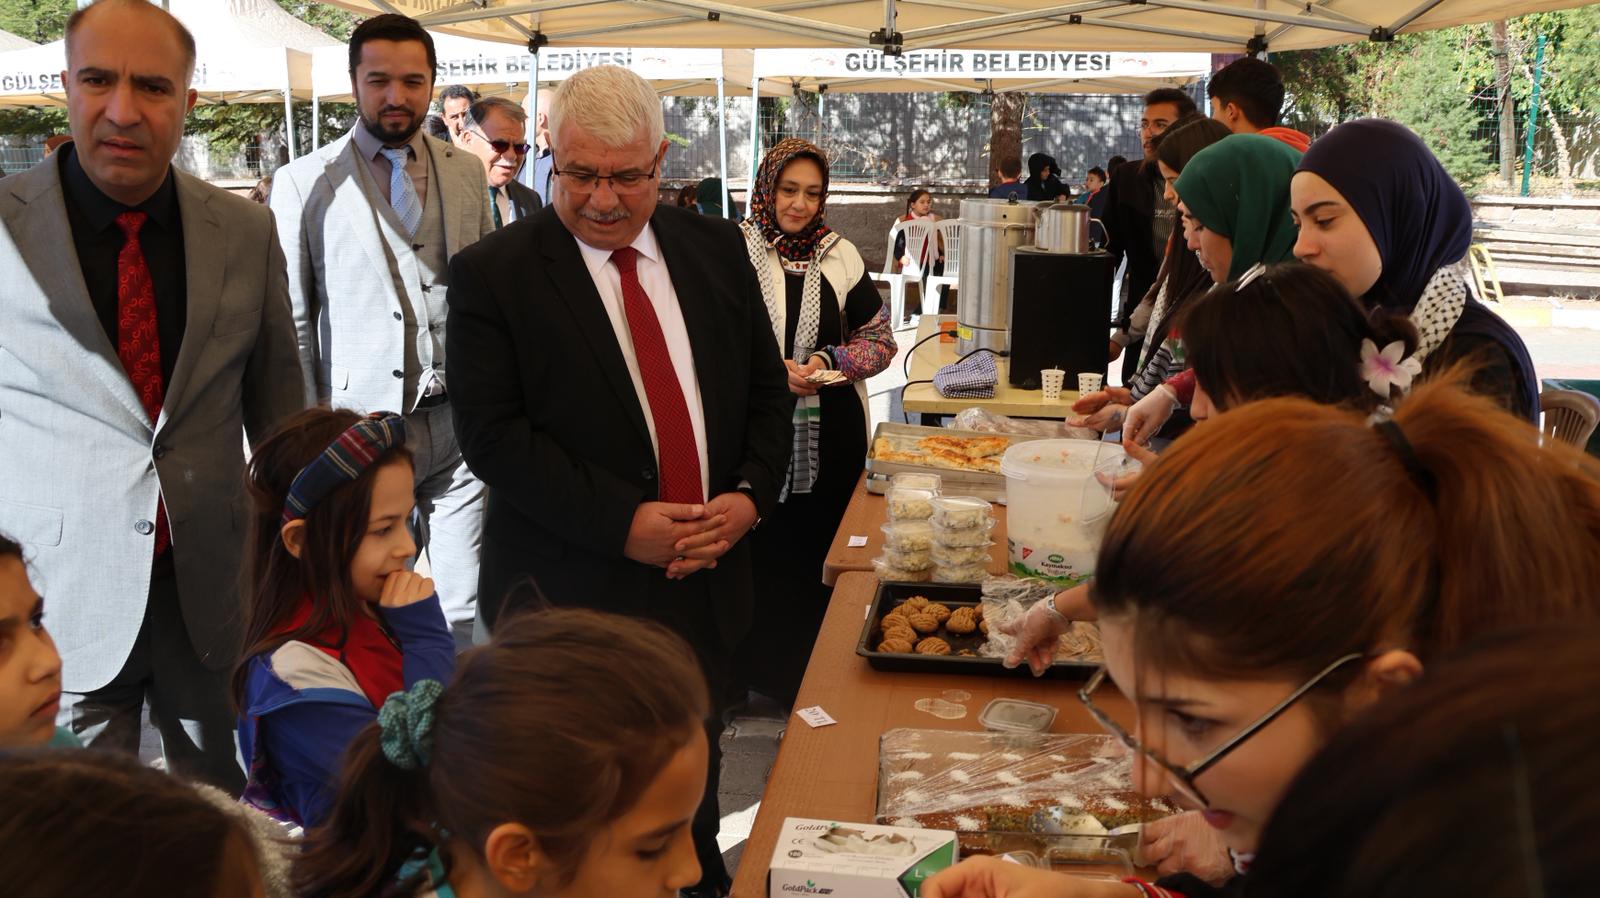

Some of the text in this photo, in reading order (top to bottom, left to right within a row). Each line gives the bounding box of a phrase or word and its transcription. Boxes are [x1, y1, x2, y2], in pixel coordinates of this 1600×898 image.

[436, 48, 632, 82] ŞEHİR BEEDİYESİ
[845, 49, 1111, 77] GÜLŞEHİR BELEDİYESİ
[2, 71, 62, 95] GÜLŞE
[915, 869, 923, 877] L
